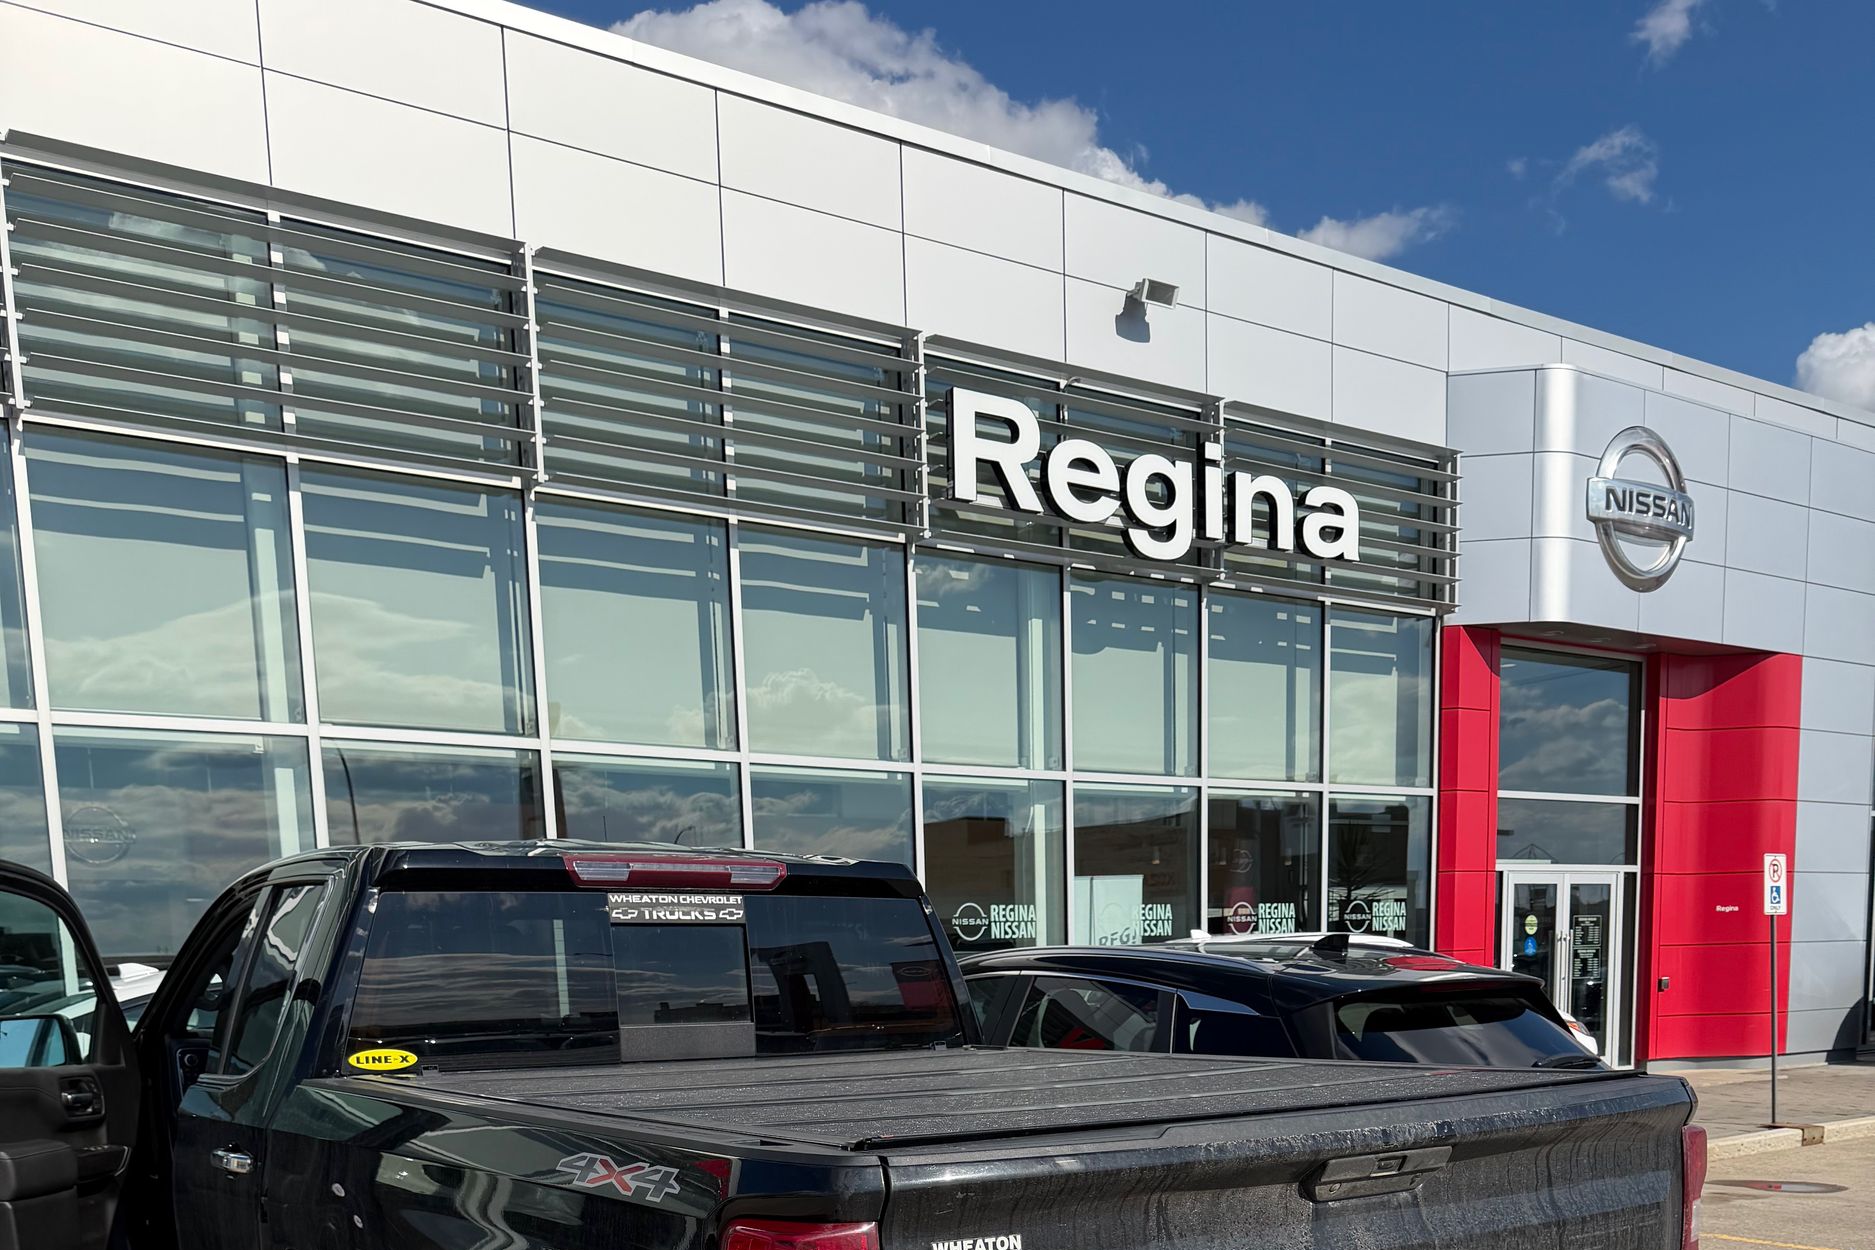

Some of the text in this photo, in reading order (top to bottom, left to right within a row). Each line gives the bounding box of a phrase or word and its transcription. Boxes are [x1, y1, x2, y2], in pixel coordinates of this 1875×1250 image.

[949, 386, 1360, 562] Regina
[1605, 486, 1693, 530] NISSAN
[609, 895, 743, 904] WHEATON CHEVROLET
[641, 907, 717, 920] TRUCKS
[990, 904, 1036, 922] REGINA
[1258, 902, 1296, 918] REGINA
[1372, 901, 1407, 917] REGINA
[952, 917, 989, 926] NISSAN
[1258, 918, 1295, 933] NISSAN
[1372, 916, 1406, 931] NISSAN
[990, 921, 1036, 939] NISSAN
[356, 1055, 410, 1065] LINE-X
